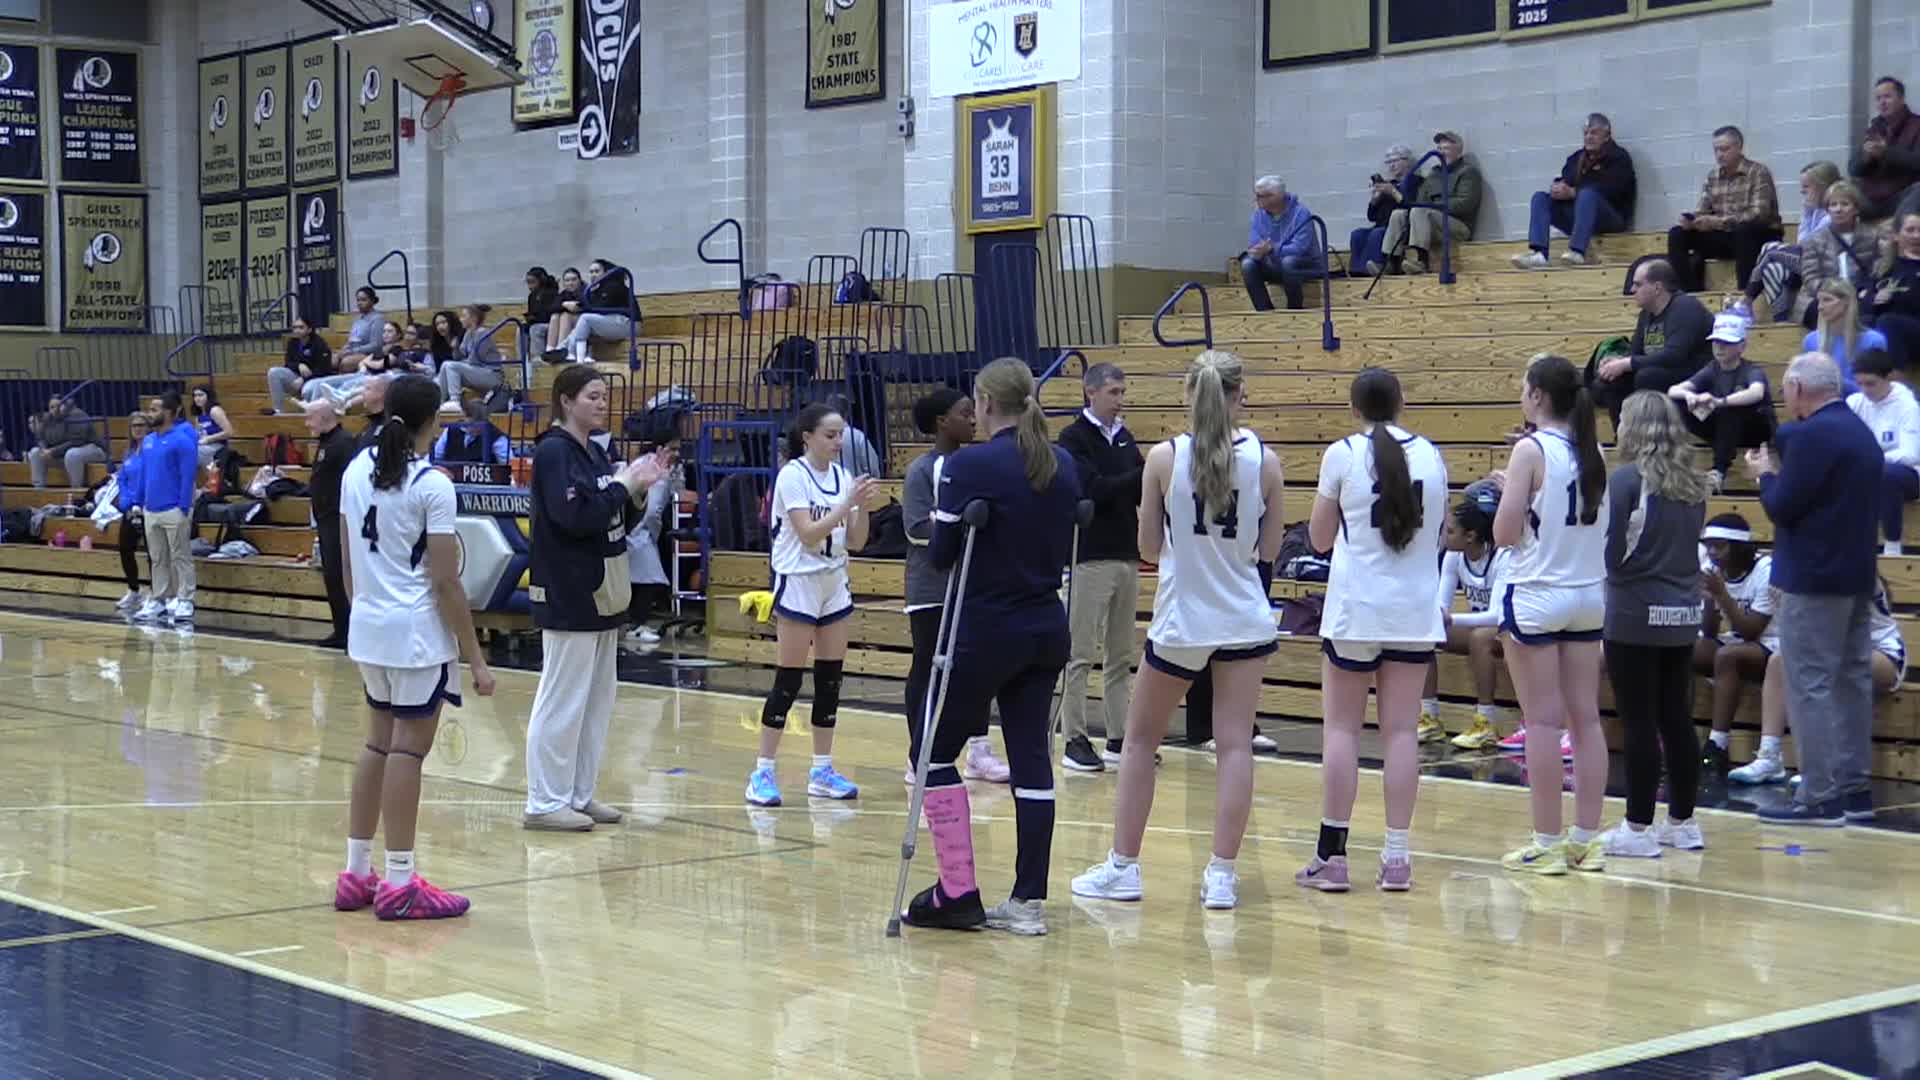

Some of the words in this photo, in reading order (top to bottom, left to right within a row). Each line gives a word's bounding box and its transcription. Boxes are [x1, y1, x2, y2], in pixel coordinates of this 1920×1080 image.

[1518, 8, 1548, 25] 2025
[832, 31, 857, 48] 1987
[827, 50, 859, 68] STATE
[811, 69, 876, 90] CHAMPIONS
[76, 103, 123, 116] LEAGUE
[63, 115, 137, 129] CHAMPIONS
[985, 140, 1014, 152] SARAH
[990, 155, 1010, 178] 33
[462, 493, 531, 513] WARRIORS
[361, 504, 379, 552] 4
